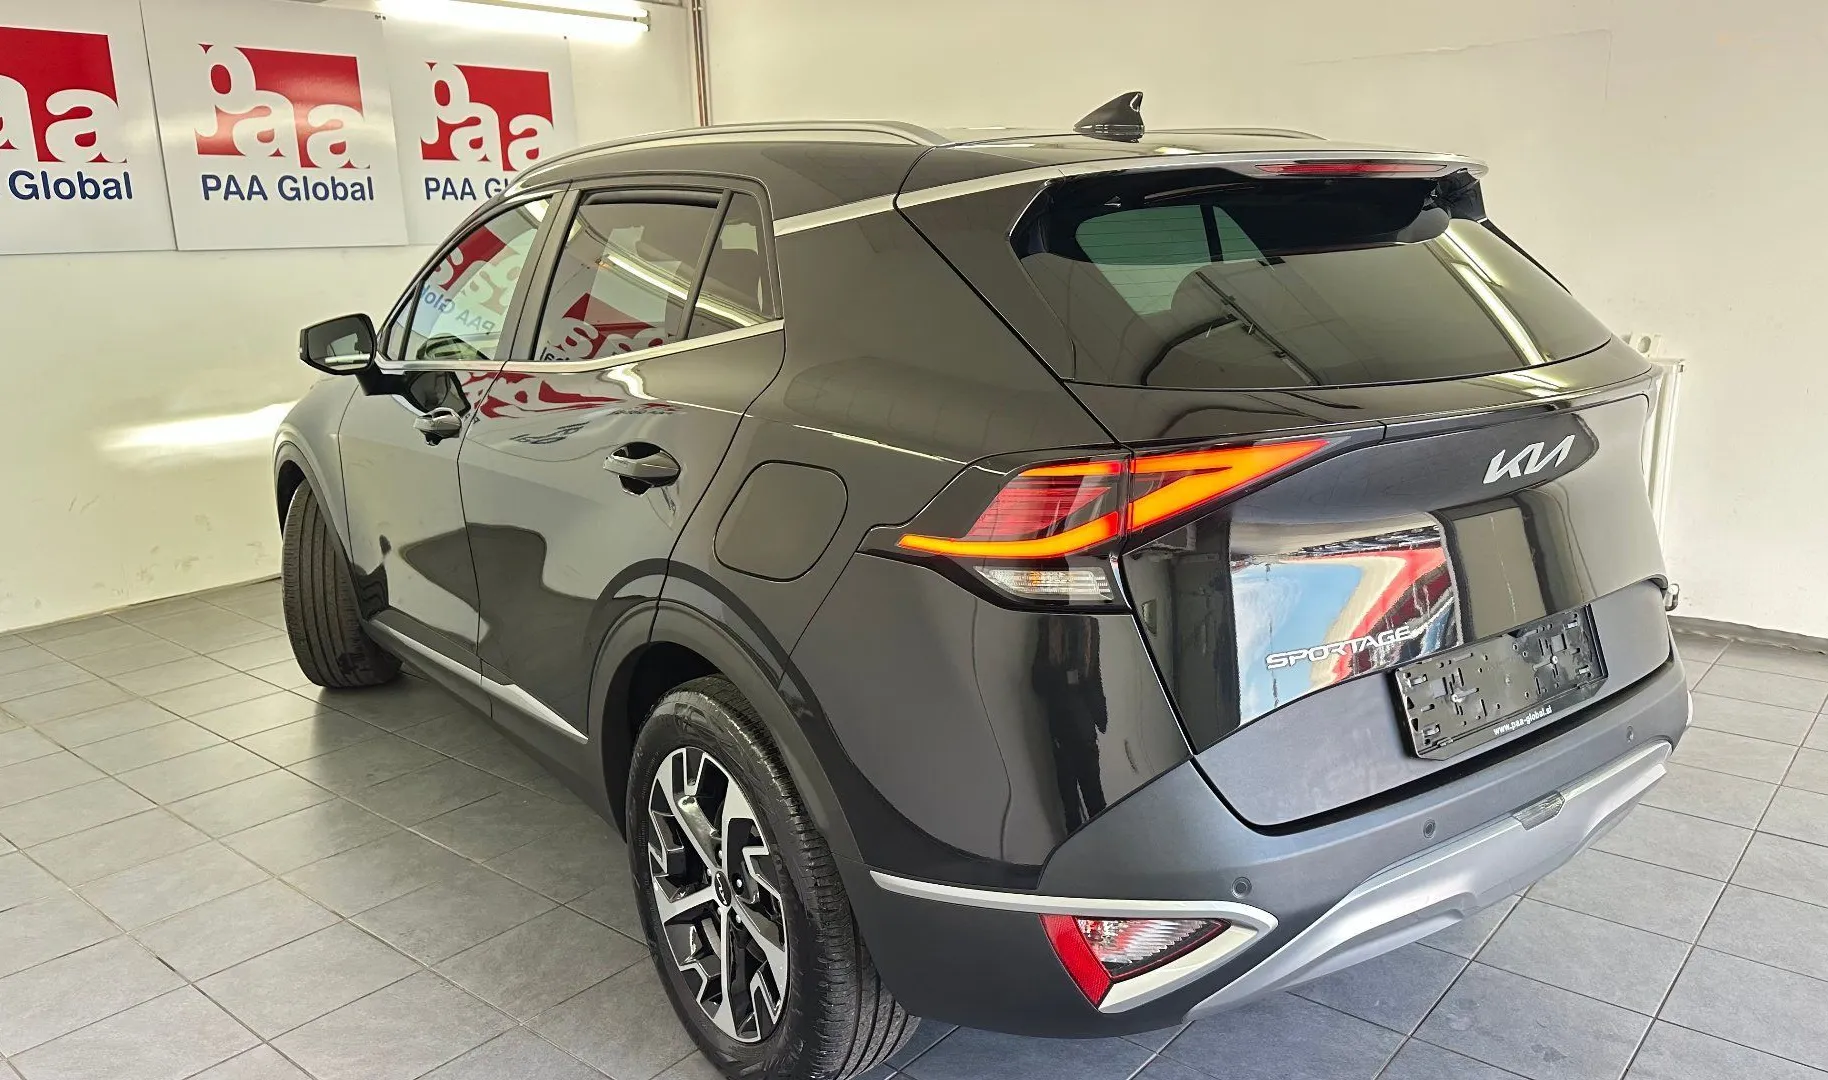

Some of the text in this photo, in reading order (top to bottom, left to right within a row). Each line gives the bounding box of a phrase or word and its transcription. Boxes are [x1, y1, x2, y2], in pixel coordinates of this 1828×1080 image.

[8, 169, 133, 201] Global
[201, 174, 374, 201] PAA Global
[424, 177, 477, 201] PAA
[1482, 434, 1576, 484] KIA
[1265, 625, 1412, 670] SPORTAGE
[1493, 704, 1553, 736] www.paa-global.si
